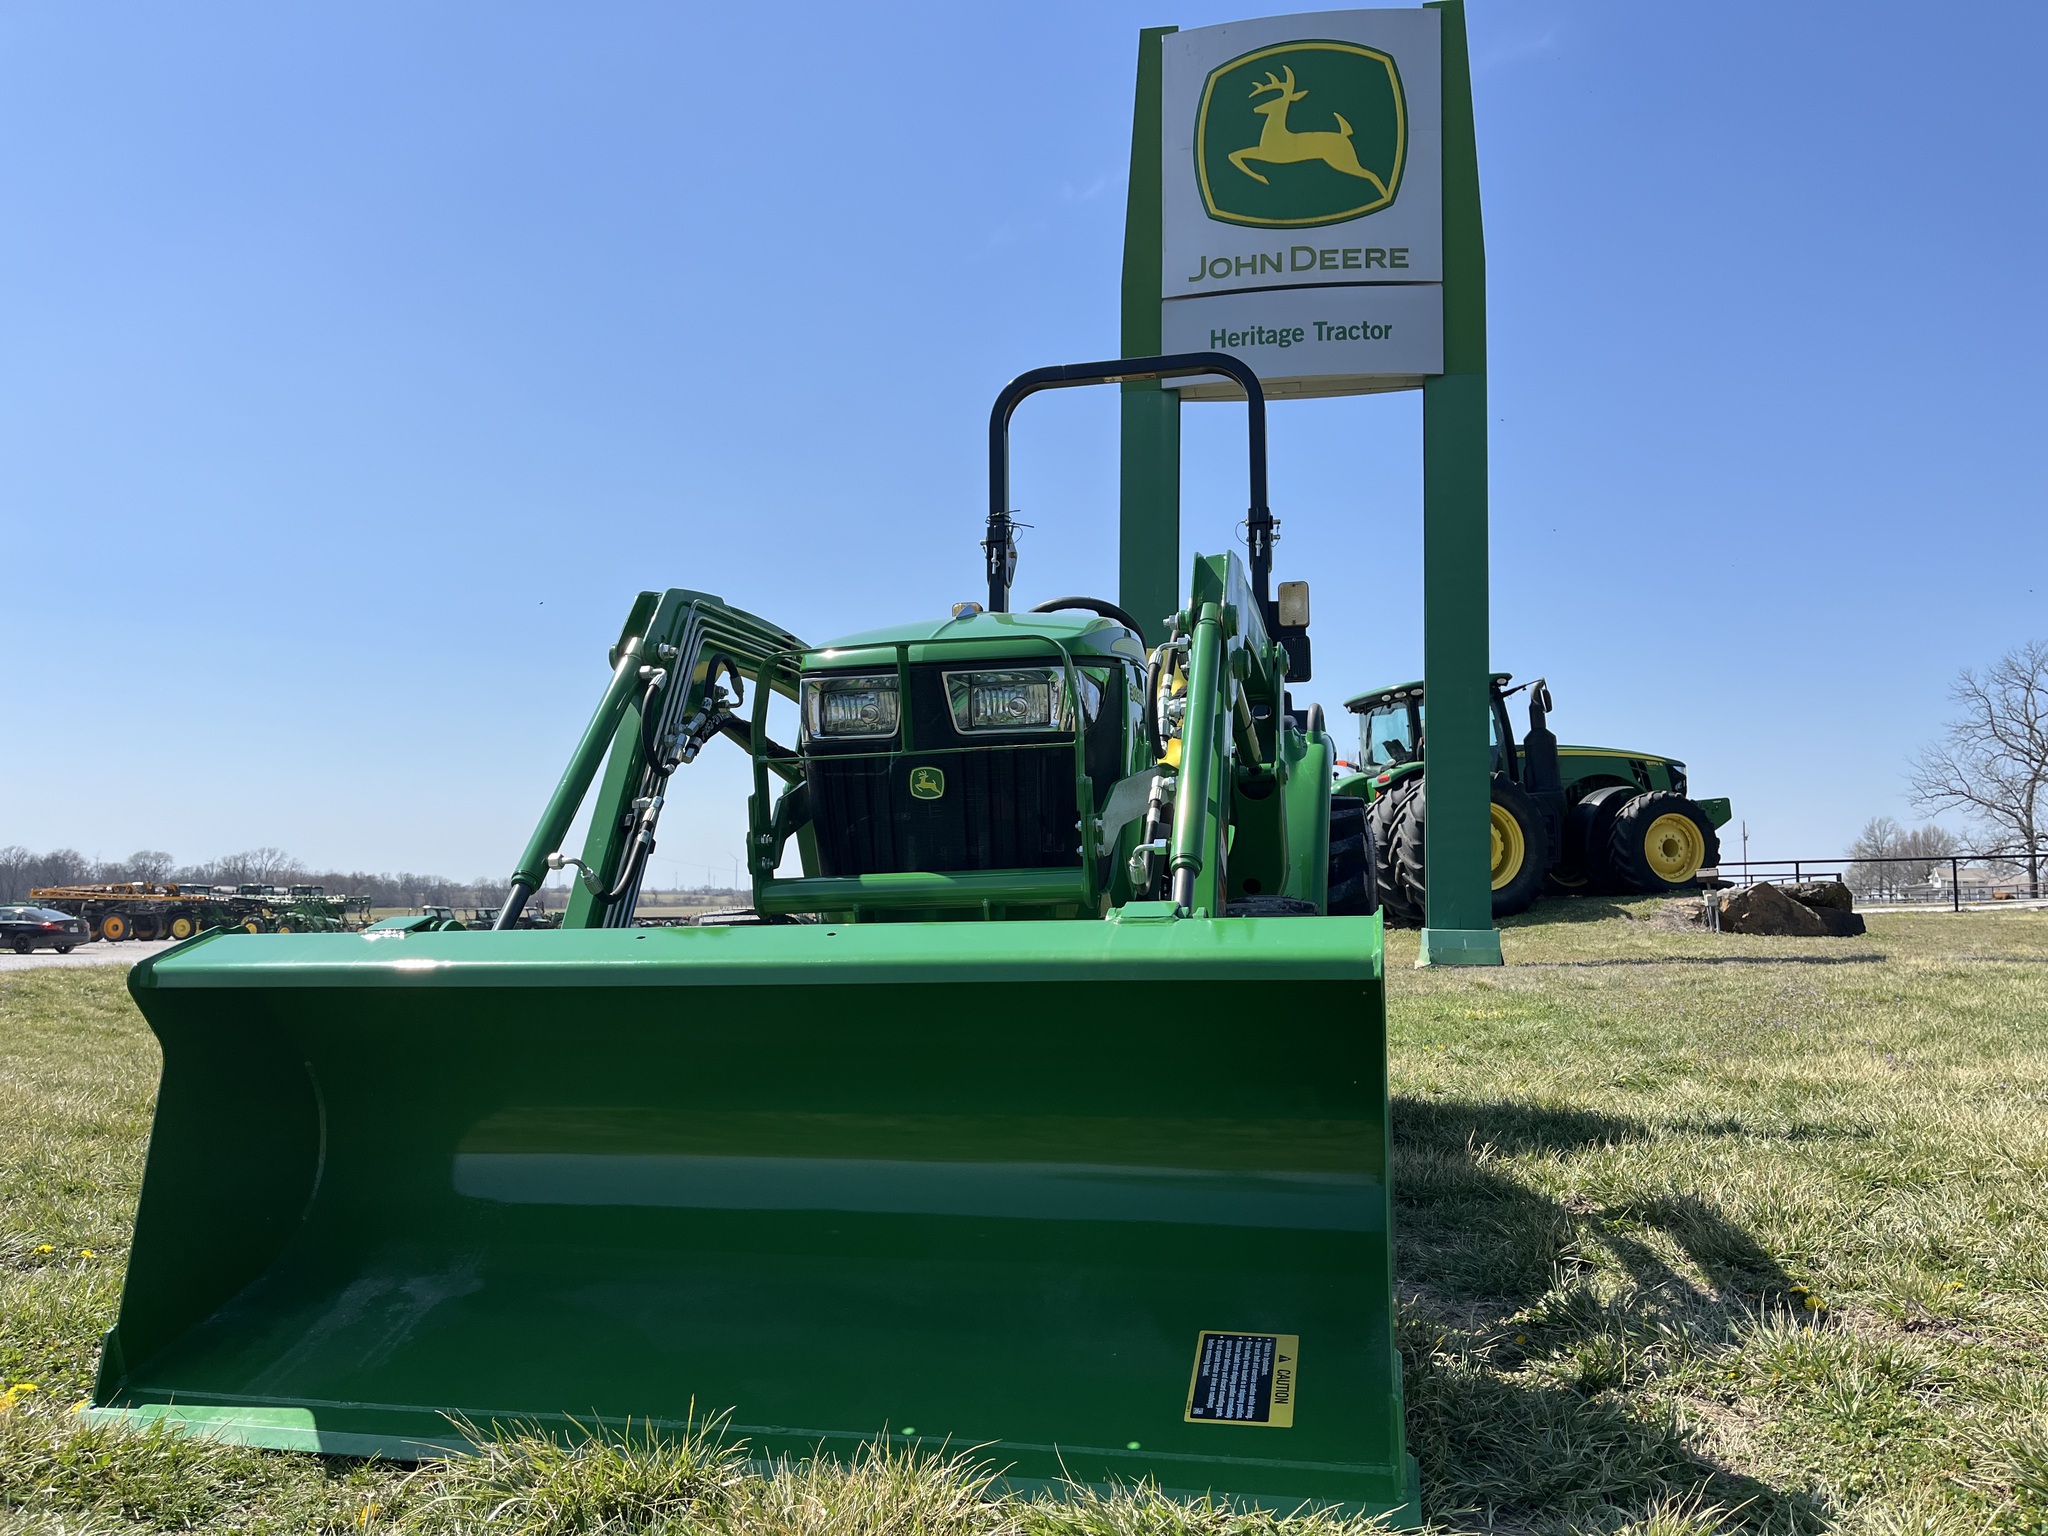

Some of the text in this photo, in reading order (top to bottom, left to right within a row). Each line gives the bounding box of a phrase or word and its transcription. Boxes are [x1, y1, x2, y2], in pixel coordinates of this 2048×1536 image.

[1188, 246, 1410, 283] JOHN DEERE
[1210, 320, 1393, 349] Heritage Tractor
[1274, 1369, 1291, 1404] CAUTION
